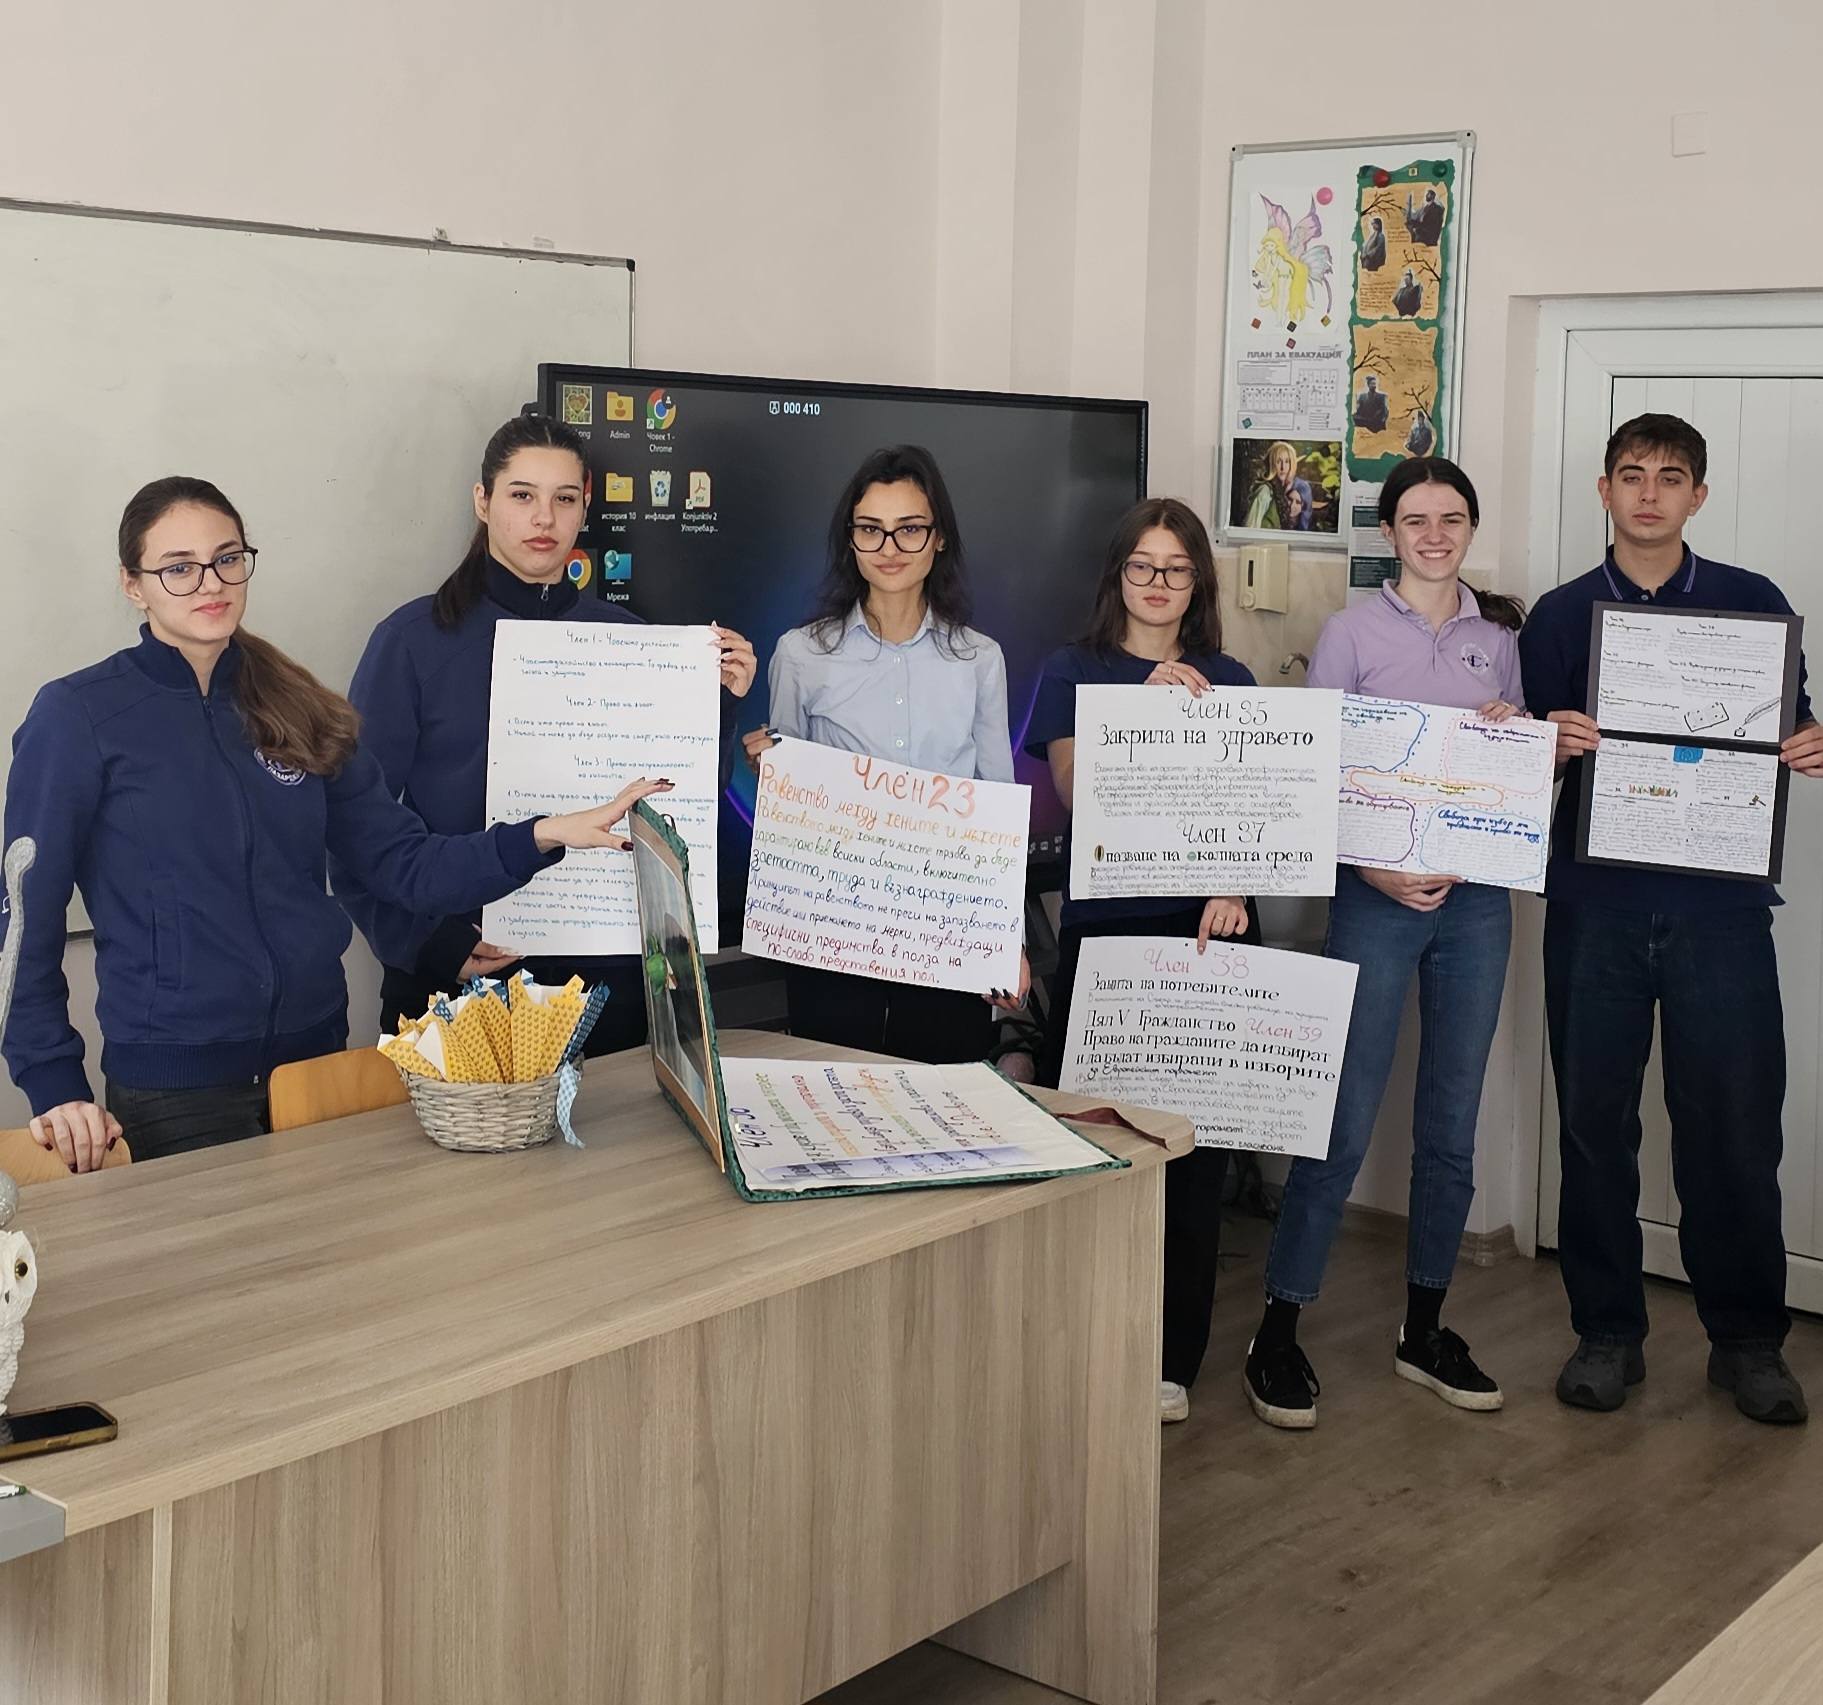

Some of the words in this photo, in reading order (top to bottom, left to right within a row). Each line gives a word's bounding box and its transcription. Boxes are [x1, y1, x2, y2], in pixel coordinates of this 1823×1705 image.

[783, 401, 800, 414] 000
[802, 402, 820, 415] 410
[609, 430, 630, 439] Admin
[649, 444, 672, 453] Chrome
[682, 512, 712, 521] Konjunktiv
[606, 593, 630, 602] Мрежа
[1178, 698, 1231, 719] Член
[1239, 700, 1268, 725] 35
[1099, 723, 1175, 762] Закрила
[1183, 729, 1207, 744] на
[1214, 729, 1314, 762] здравето
[853, 752, 926, 804] Член
[928, 775, 977, 818] 23
[761, 763, 829, 809] Равенство
[835, 802, 878, 830] между
[884, 811, 940, 835] жените
[945, 823, 956, 838] и
[960, 828, 1022, 848] мъжете
[1177, 821, 1226, 844] Член
[1238, 821, 1266, 844] 37
[923, 859, 997, 886] включително
[936, 845, 970, 861] трябва
[974, 854, 987, 868] да
[991, 848, 1018, 873] бъде
[1162, 851, 1180, 862] на
[1265, 851, 1313, 869] среда
[827, 869, 866, 893] труда
[871, 879, 880, 890] и
[803, 887, 814, 897] на
[877, 905, 888, 914] не
[890, 908, 921, 921] пречи
[925, 913, 937, 922] на
[1010, 916, 1020, 933] в
[865, 923, 877, 933] на
[820, 954, 906, 979] представения
[891, 944, 899, 957] в
[902, 950, 939, 968] полза
[948, 956, 962, 968] на
[1144, 948, 1190, 973] Член
[1210, 952, 1250, 979] 38
[1089, 970, 1133, 990] Защита
[1140, 979, 1155, 990] на
[1160, 979, 1280, 1000] потребителите
[1085, 1009, 1114, 1029] Дял
[1118, 1009, 1131, 1026] V
[1139, 1009, 1236, 1031] Гражданство
[1247, 1018, 1293, 1039] Член
[1298, 1024, 1323, 1042] 39
[1084, 1029, 1125, 1050] Право
[1128, 1034, 1144, 1045] на
[1146, 1034, 1236, 1050] гражданите
[1240, 1041, 1259, 1054] да
[1262, 1043, 1331, 1063] избират
[1076, 1053, 1084, 1065] и
[1085, 1053, 1102, 1065] да
[1104, 1053, 1142, 1064] бъдат
[1145, 1053, 1223, 1070] избирани
[1229, 1058, 1239, 1068] в
[1244, 1060, 1336, 1081] изборите
